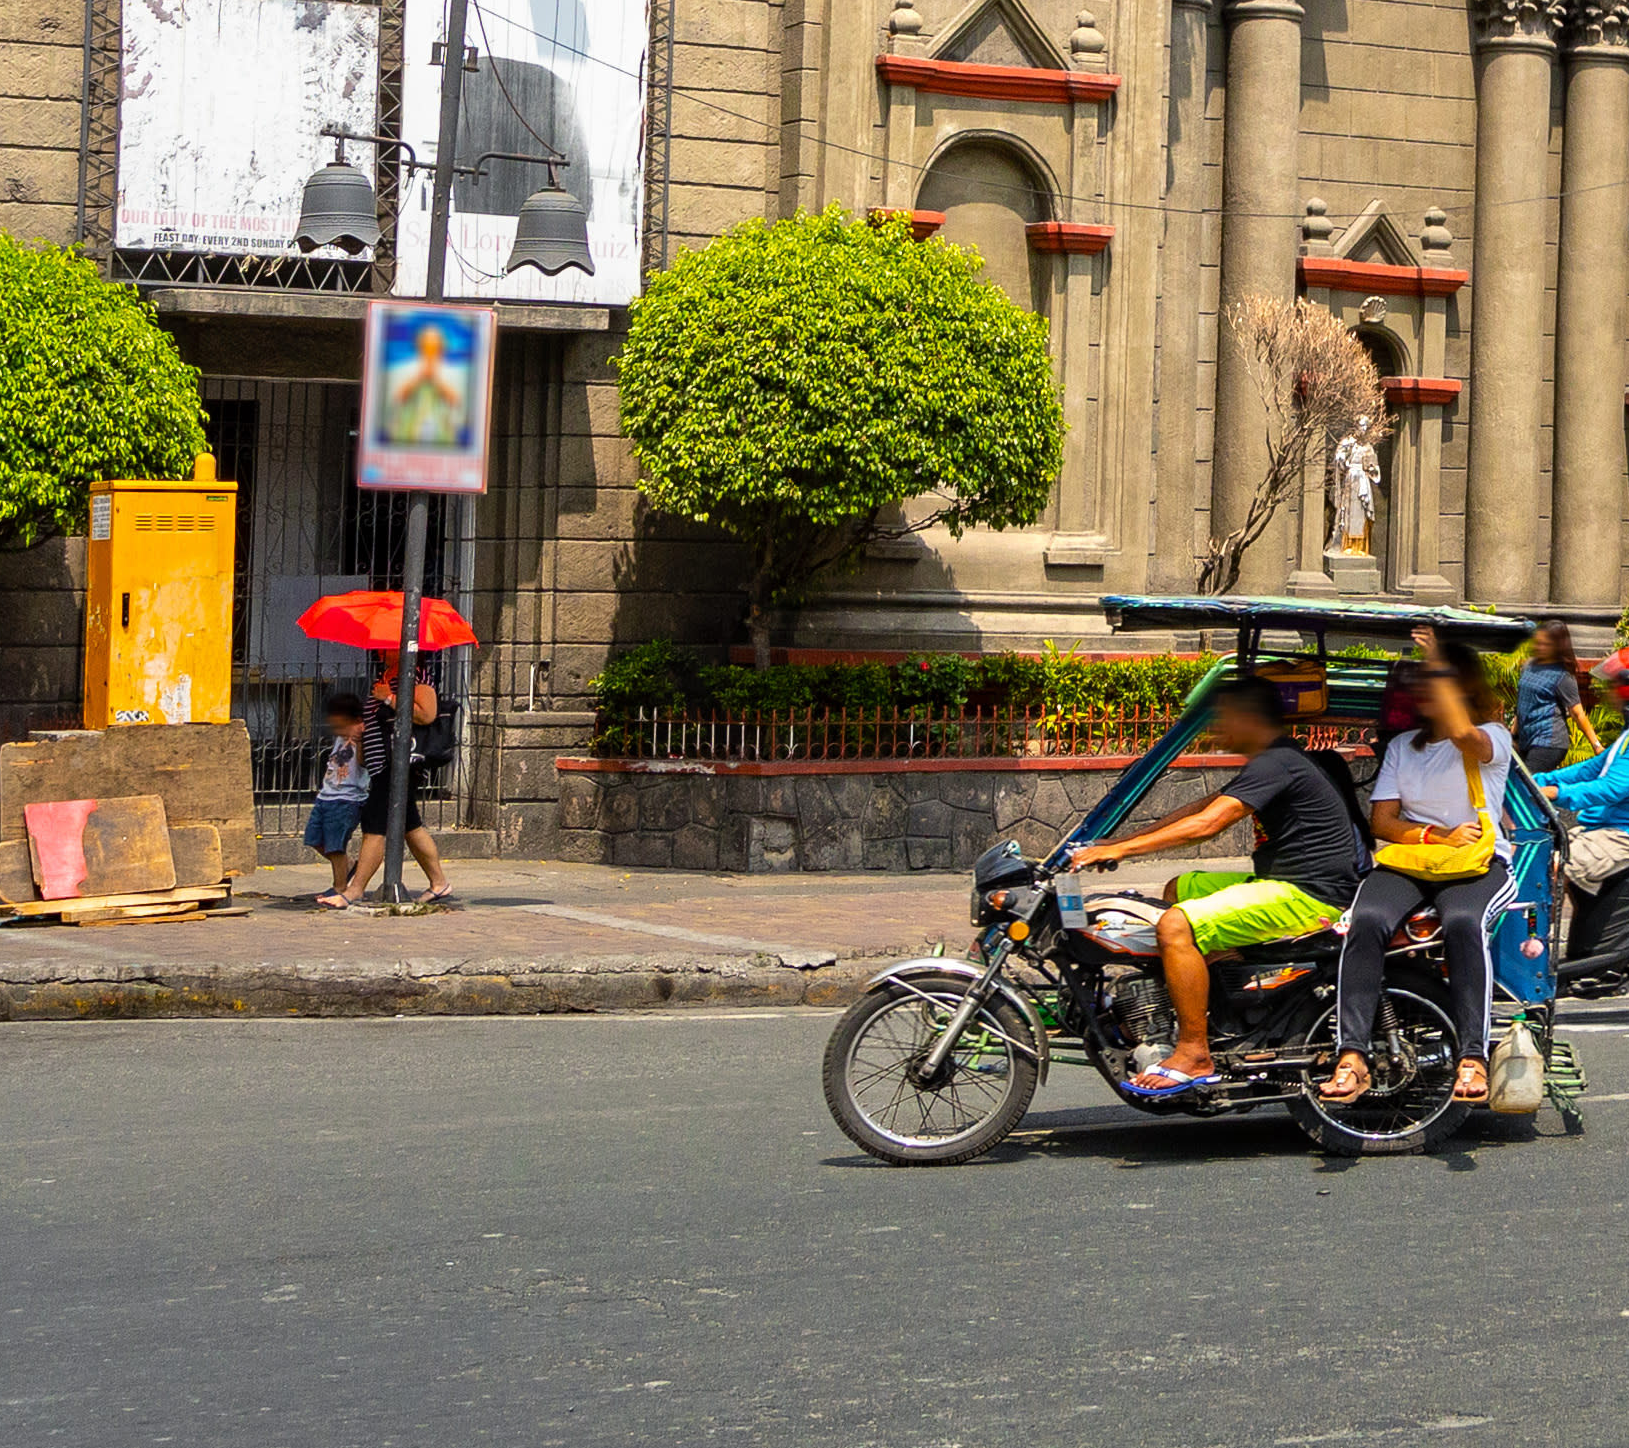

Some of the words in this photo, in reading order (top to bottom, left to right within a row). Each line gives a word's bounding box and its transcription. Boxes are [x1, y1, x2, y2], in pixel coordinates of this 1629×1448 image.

[122, 209, 149, 224] OUR
[192, 212, 207, 228] OF
[212, 214, 236, 229] THE
[240, 216, 278, 232] MOST
[153, 232, 179, 243] FEAST
[202, 235, 229, 246] EVERY
[231, 236, 249, 247] 2ND
[251, 238, 285, 249] SUNDAY
